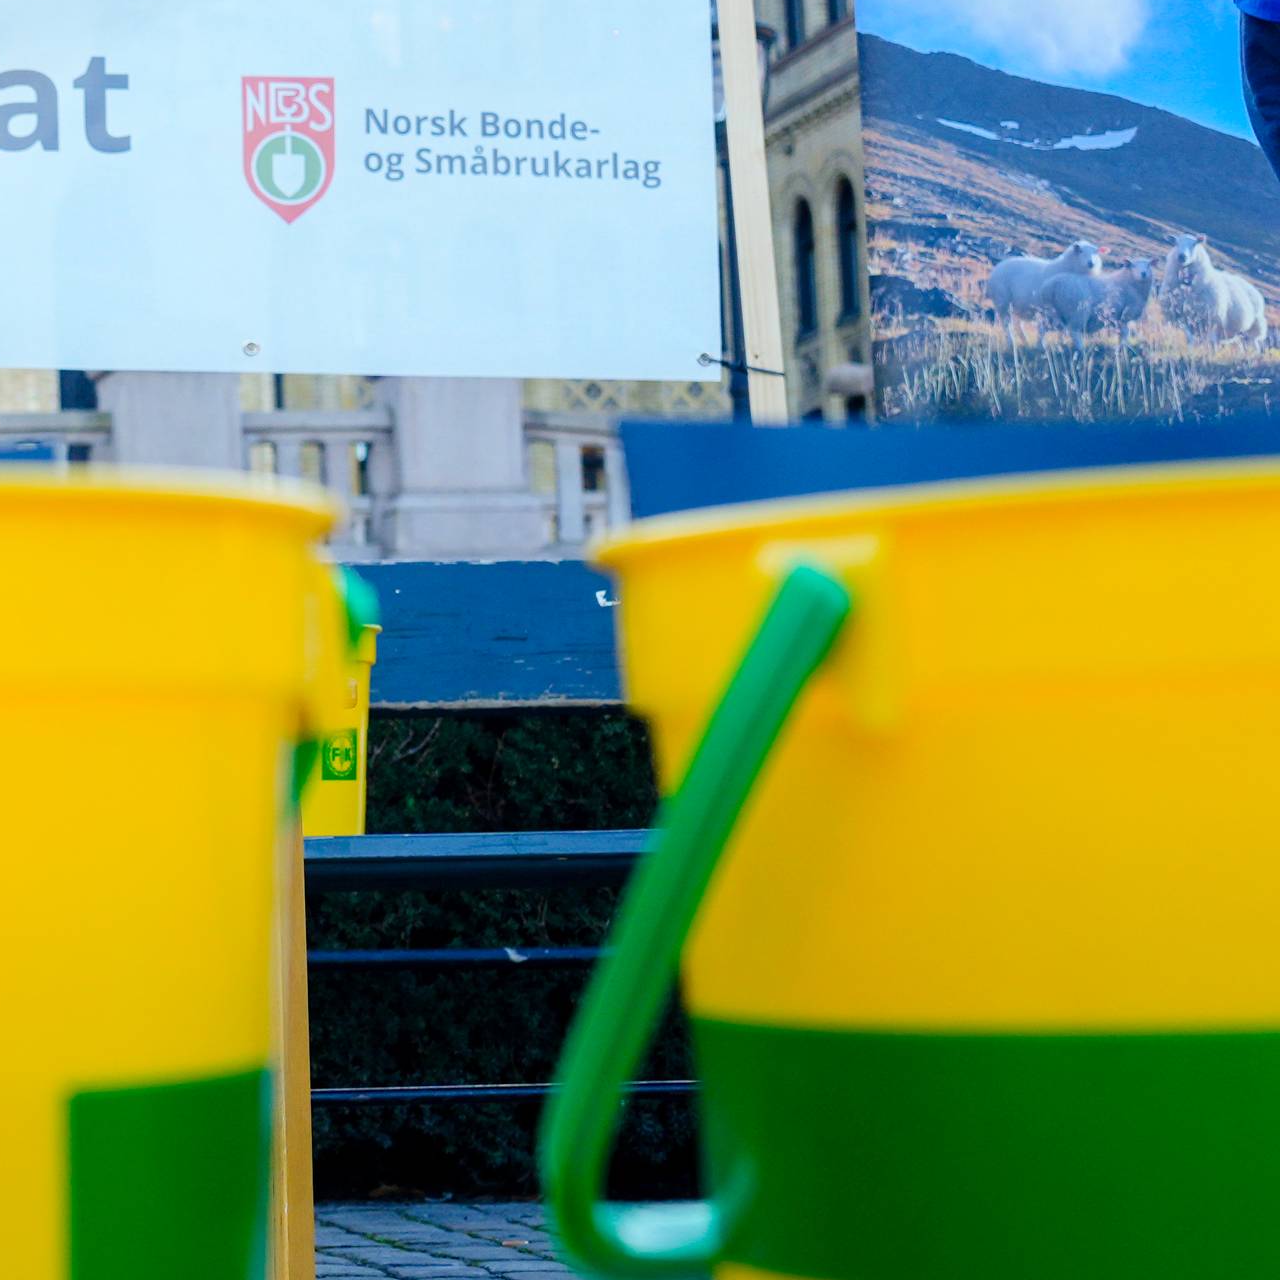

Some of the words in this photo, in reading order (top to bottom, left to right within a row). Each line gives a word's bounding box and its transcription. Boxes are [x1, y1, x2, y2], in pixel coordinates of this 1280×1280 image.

[364, 108, 469, 138] Norsk
[480, 111, 600, 141] Bonde-
[363, 150, 405, 182] og
[414, 145, 662, 189] Småbrukarlag
